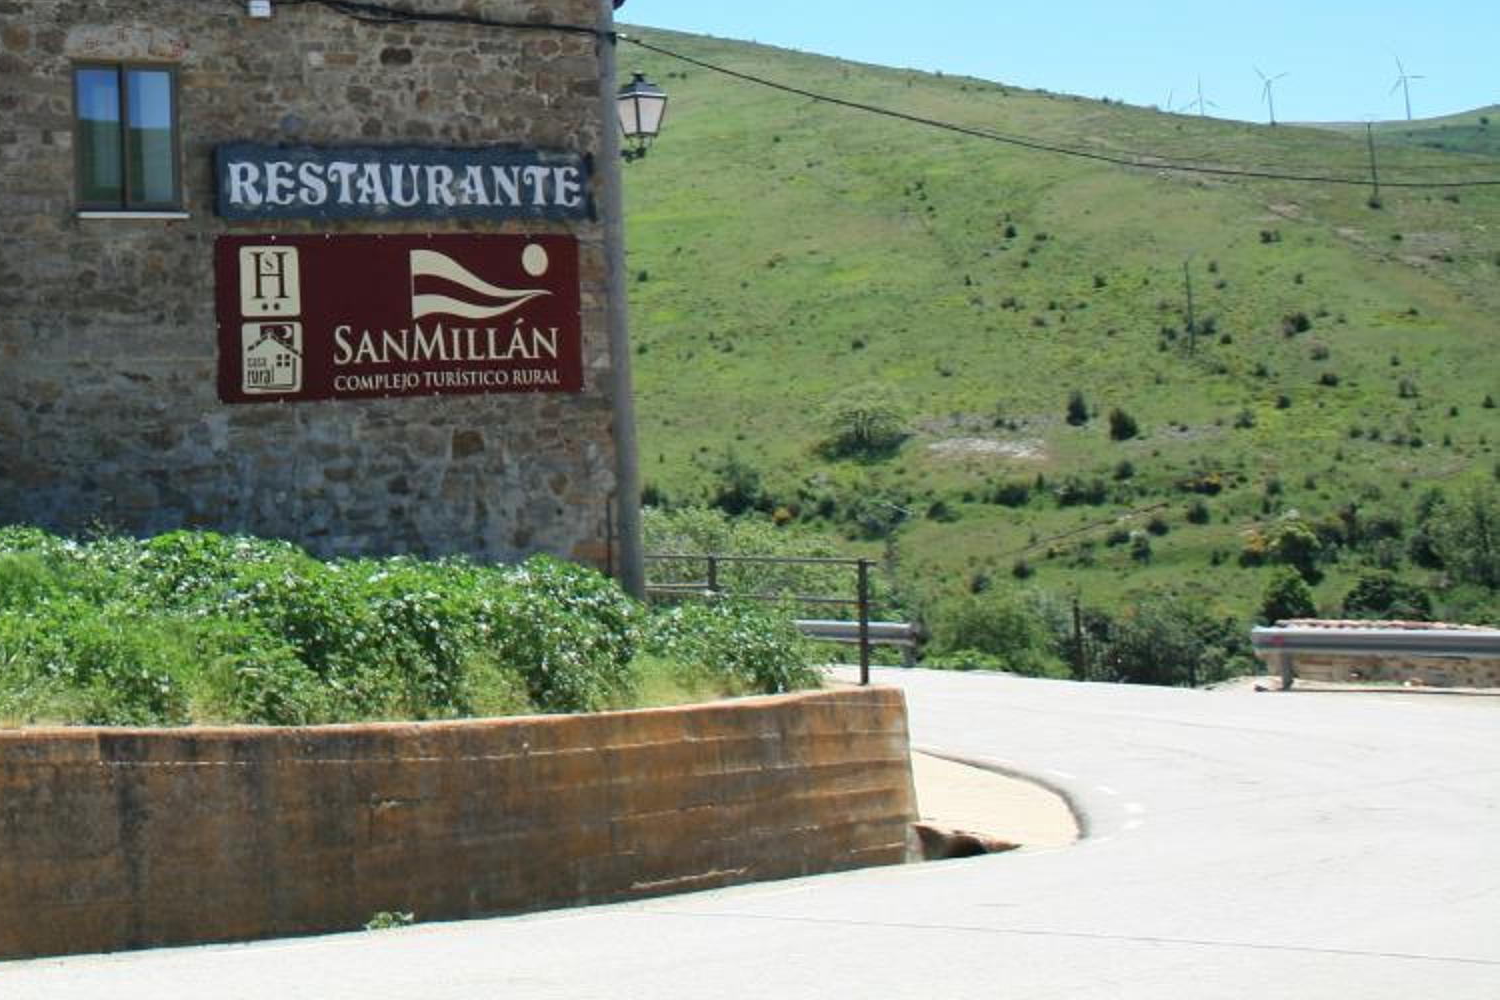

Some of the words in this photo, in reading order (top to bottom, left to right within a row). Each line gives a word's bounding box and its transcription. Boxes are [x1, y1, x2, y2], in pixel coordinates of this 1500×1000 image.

[227, 161, 582, 207] RESTAURANTE
[247, 363, 275, 385] rural
[333, 371, 420, 392] COMPLEJO
[423, 368, 509, 387] TURÍSTICO
[512, 368, 560, 385] RURAL
